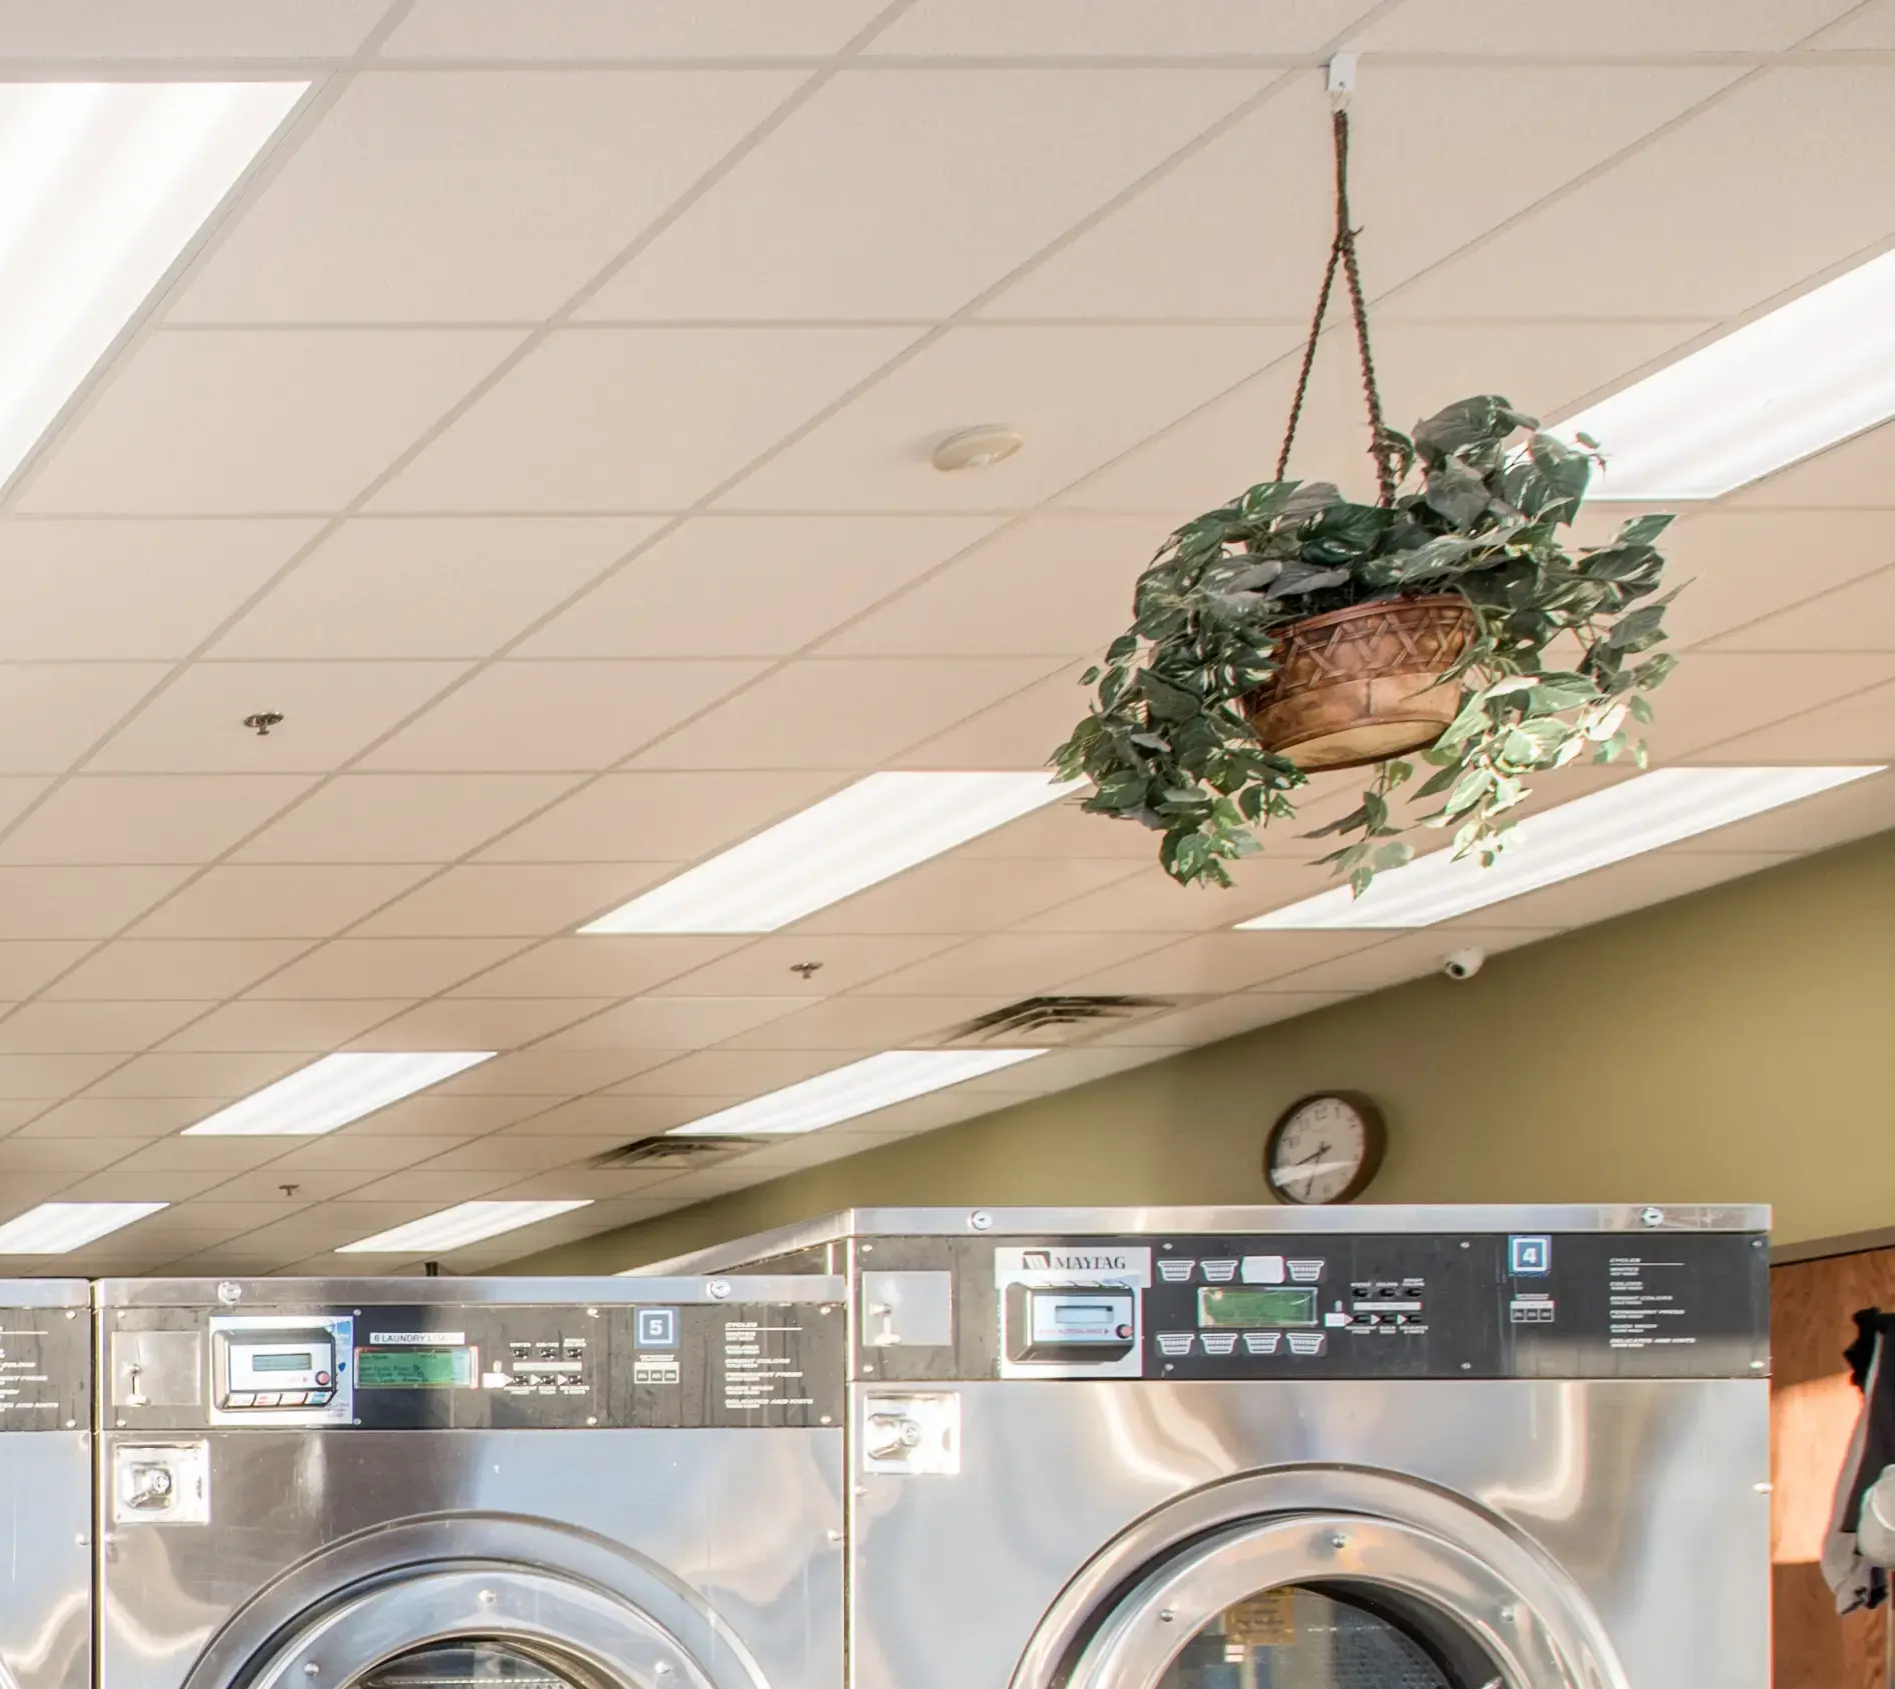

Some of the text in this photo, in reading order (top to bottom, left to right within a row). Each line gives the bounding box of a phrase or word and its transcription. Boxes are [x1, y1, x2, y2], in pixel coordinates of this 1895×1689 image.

[1056, 1256, 1126, 1269] MAYTAG
[1522, 1247, 1538, 1264] 4
[649, 1319, 663, 1335] 5
